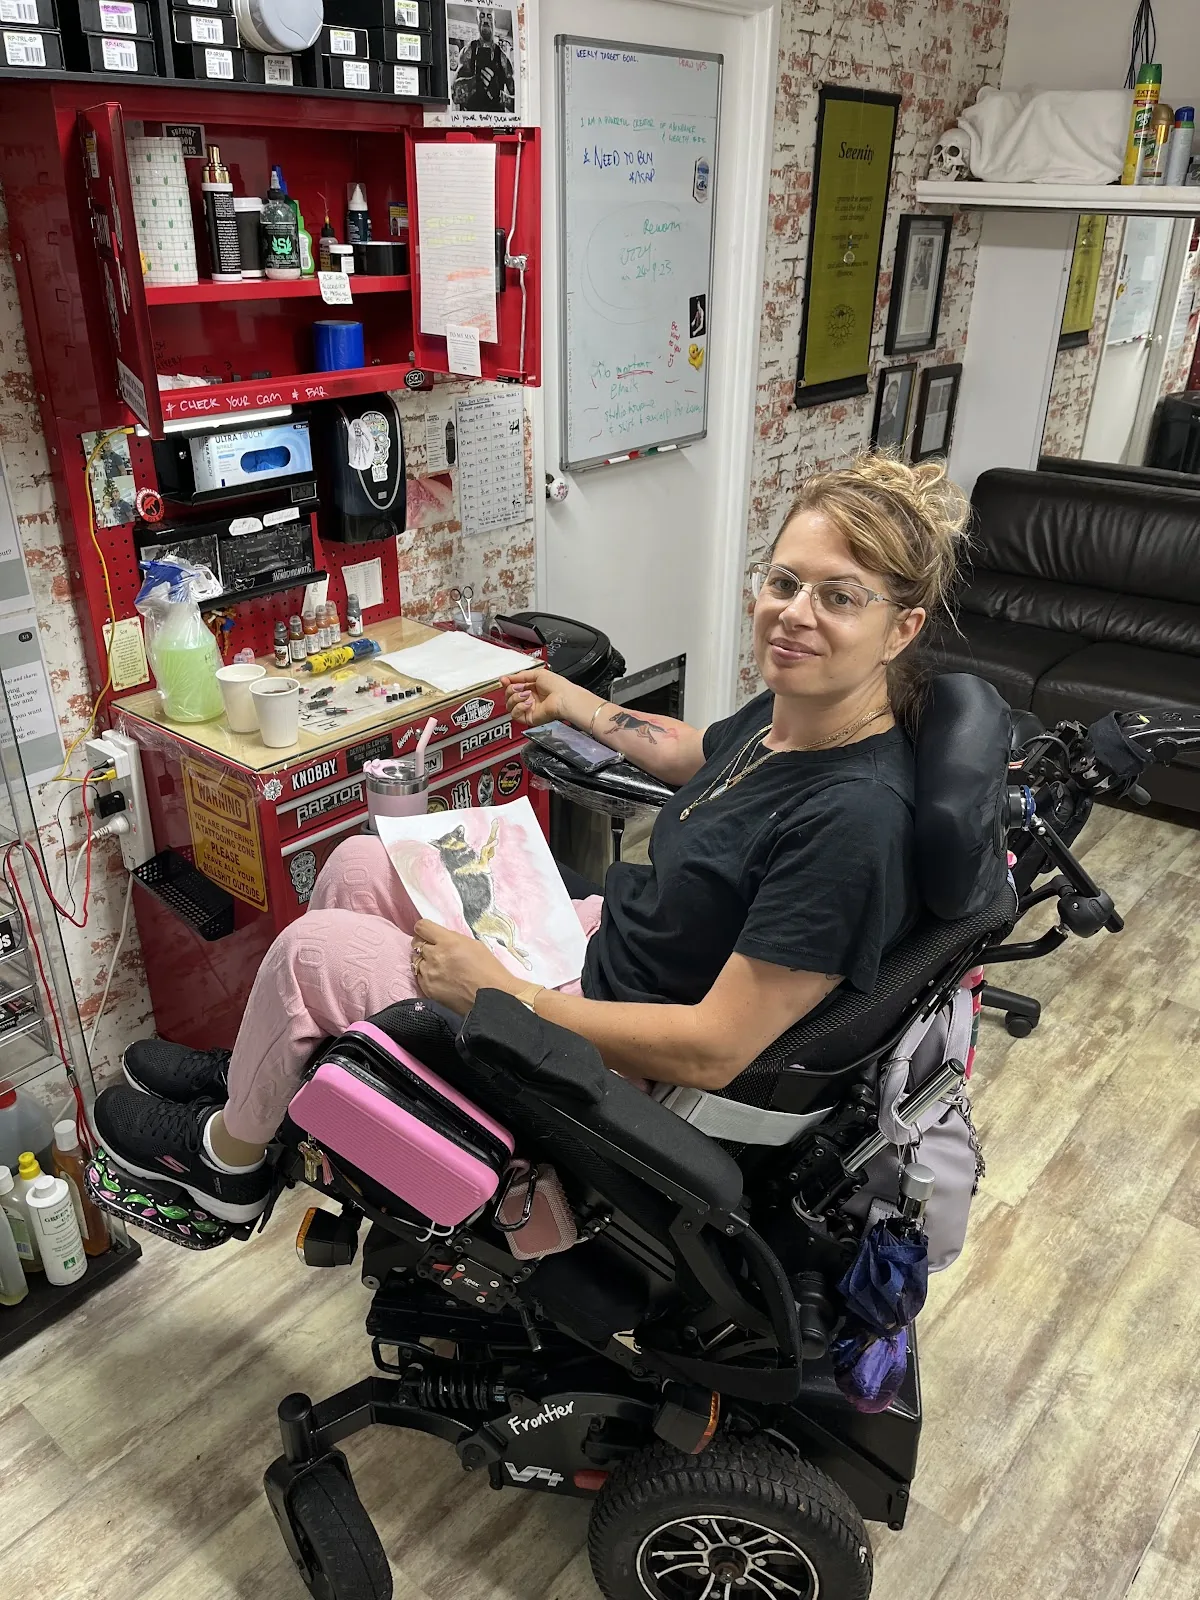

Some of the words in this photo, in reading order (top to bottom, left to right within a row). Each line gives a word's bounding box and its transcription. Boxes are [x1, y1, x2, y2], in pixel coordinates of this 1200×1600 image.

[171, 127, 196, 137] SUPPORT
[594, 145, 620, 170] NEED
[624, 150, 634, 165] TO
[638, 150, 653, 167] BUY
[408, 373, 422, 385] SCA
[179, 398, 221, 412] CHECK
[225, 396, 251, 411] YOUR
[256, 393, 283, 405] CAM
[305, 385, 329, 399] BAR
[215, 433, 238, 444] ULTRA
[238, 431, 263, 441] TOUCH
[15, 712, 27, 720] you
[27, 708, 43, 716] want
[464, 699, 480, 713] VANS
[467, 709, 478, 721] THE
[460, 722, 512, 760] RAPTOR
[197, 781, 242, 819] WARNING
[296, 783, 364, 829] RAPTOR
[193, 811, 207, 824] YOU
[207, 818, 221, 831] ARE
[221, 823, 255, 848] ENTERING
[200, 826, 236, 850] TATTOOING
[237, 844, 256, 859] ZONE
[210, 841, 241, 867] PLEASE
[203, 852, 223, 867] LEAVE
[224, 863, 236, 875] ALL
[238, 870, 256, 885] YOUR
[203, 862, 231, 886] BULLSHIT
[232, 877, 261, 900] OUTSIDE
[44, 1209, 69, 1223] GREEN
[507, 1400, 575, 1436] Frontier
